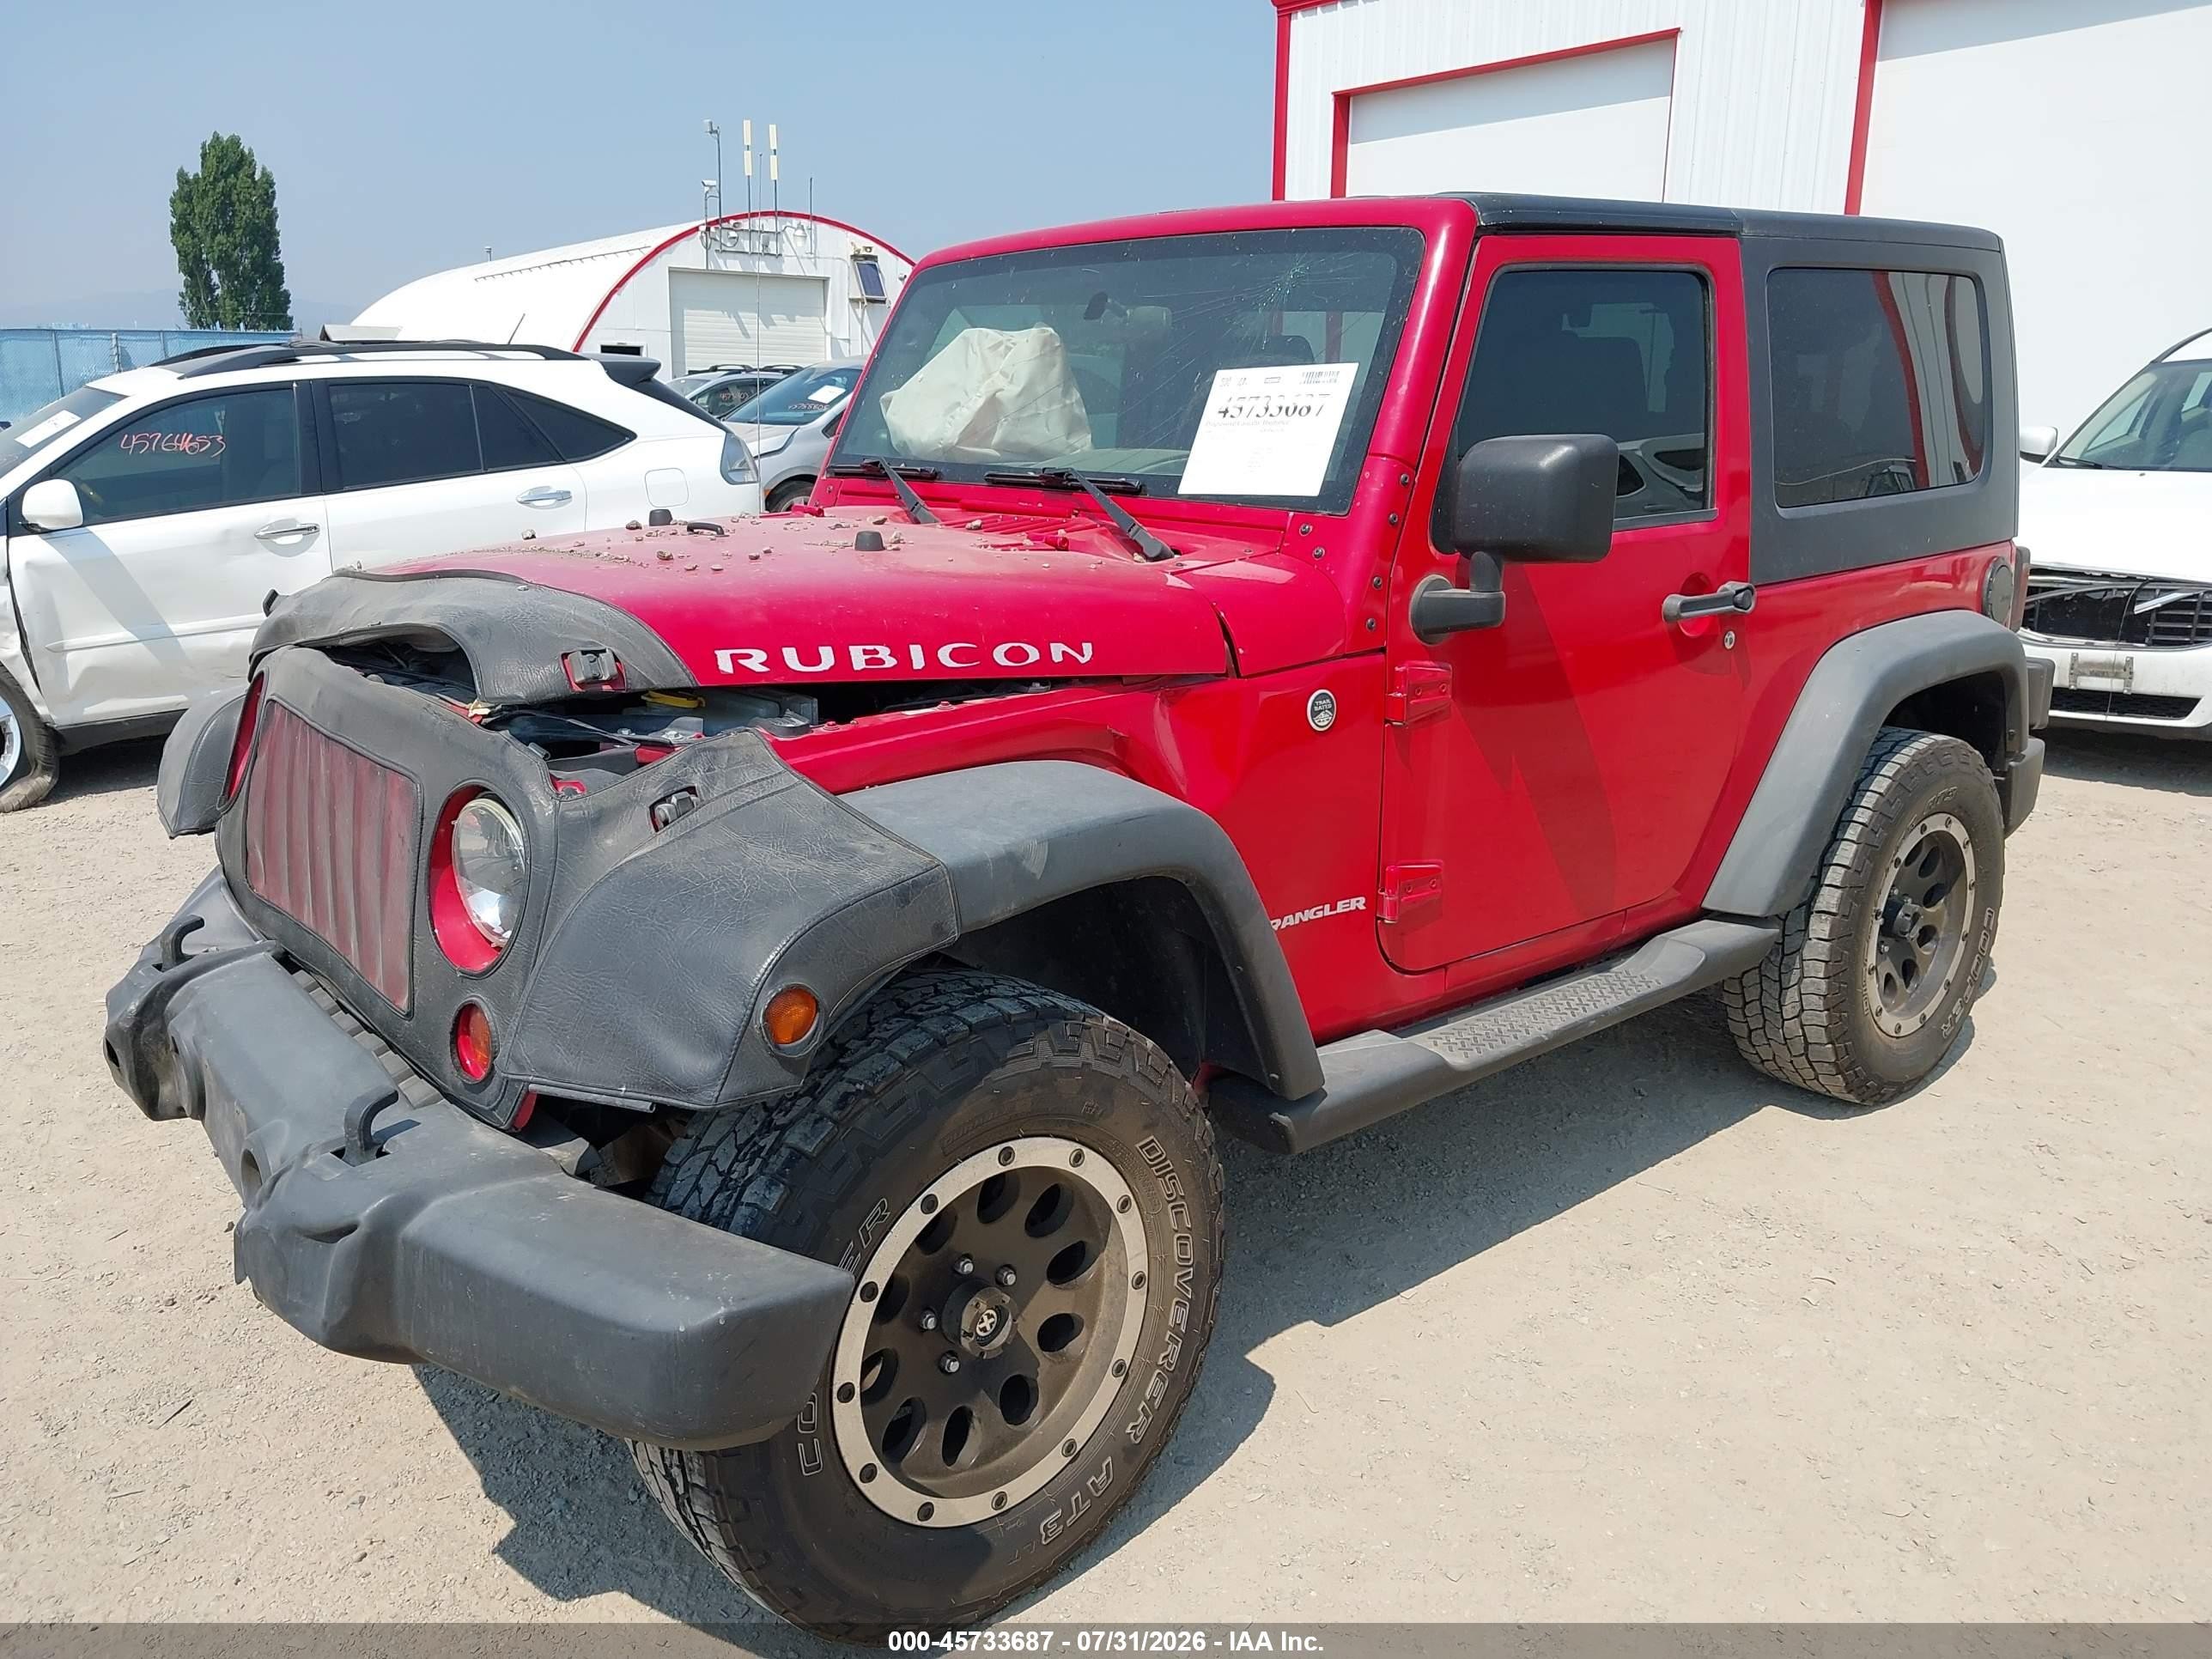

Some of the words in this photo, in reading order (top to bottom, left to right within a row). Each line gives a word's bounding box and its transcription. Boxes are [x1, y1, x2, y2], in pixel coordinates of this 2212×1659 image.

[714, 641, 1094, 675] RUBICON
[1270, 896, 1367, 932] RANGLER
[1127, 1134, 1194, 1445] DISCOVERER
[1039, 1456, 1115, 1546] AT3
